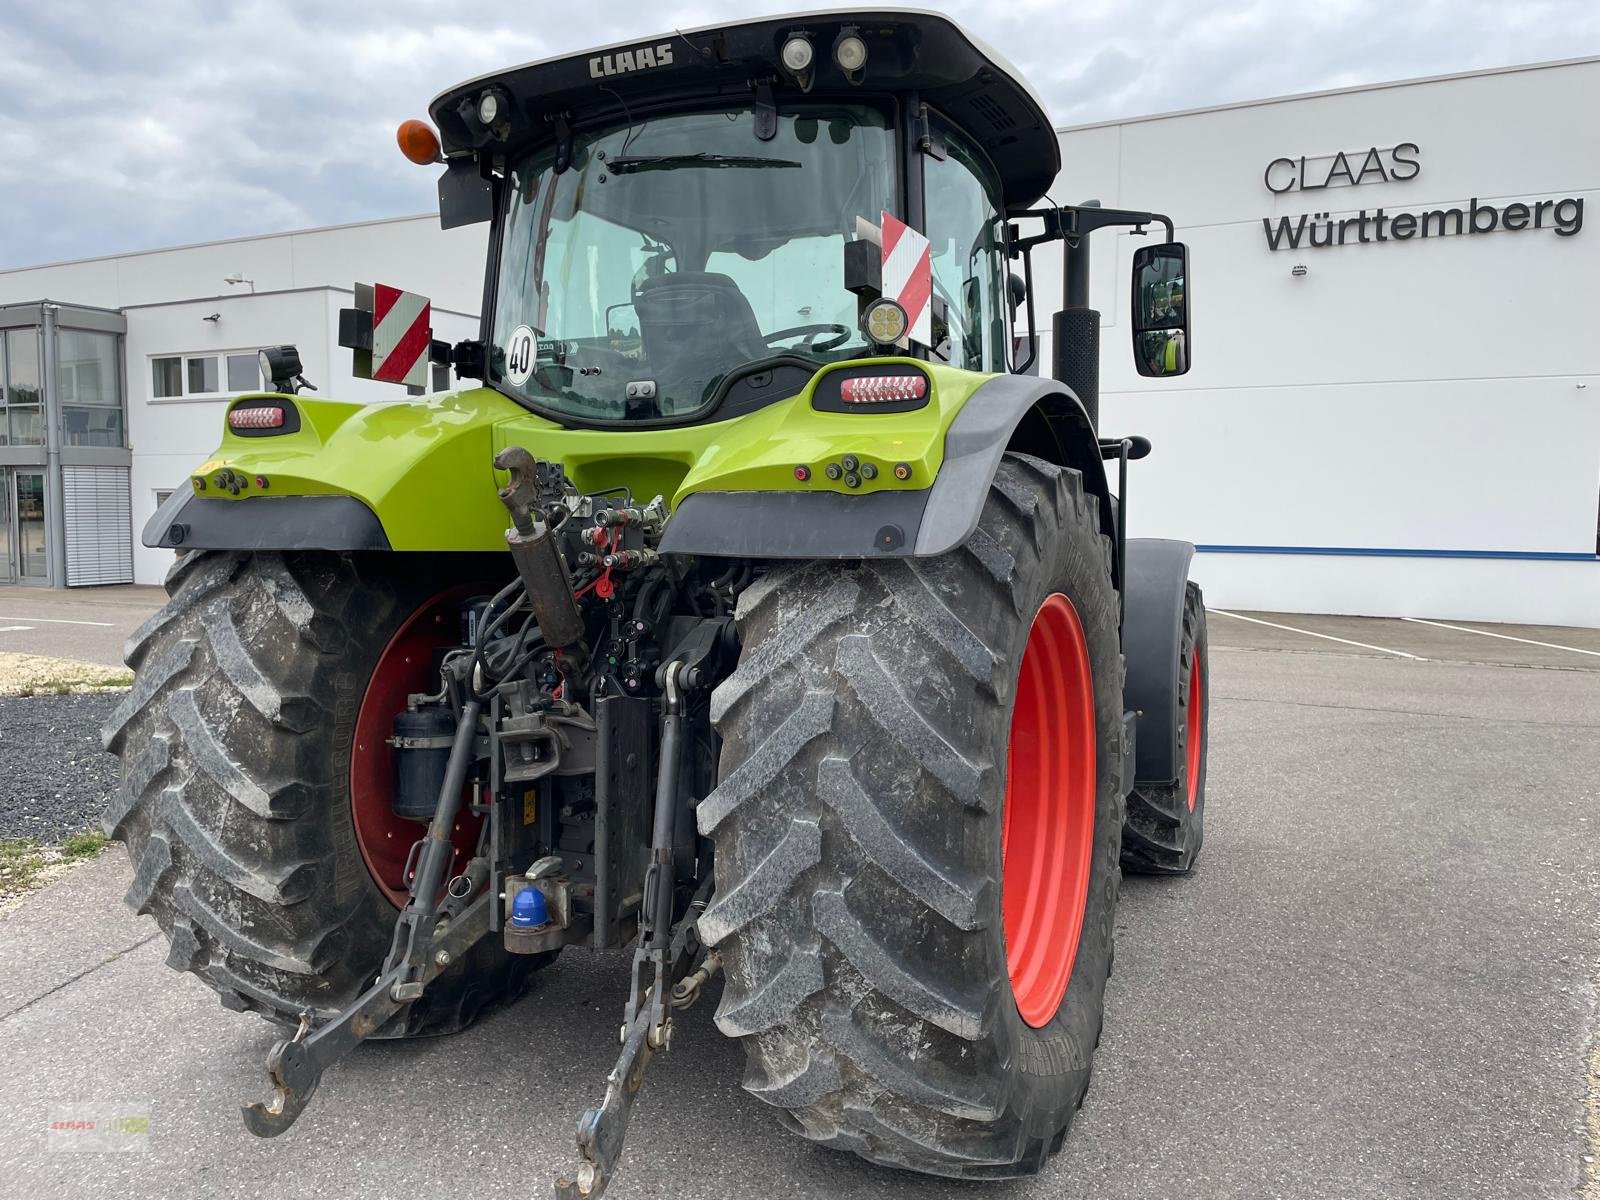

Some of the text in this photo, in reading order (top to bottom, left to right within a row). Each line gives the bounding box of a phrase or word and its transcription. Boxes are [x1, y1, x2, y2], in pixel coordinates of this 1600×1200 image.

[589, 43, 673, 78] CLAAS
[1264, 142, 1420, 193] CLAAS
[1263, 198, 1584, 250] Württemberg
[509, 336, 530, 374] 40
